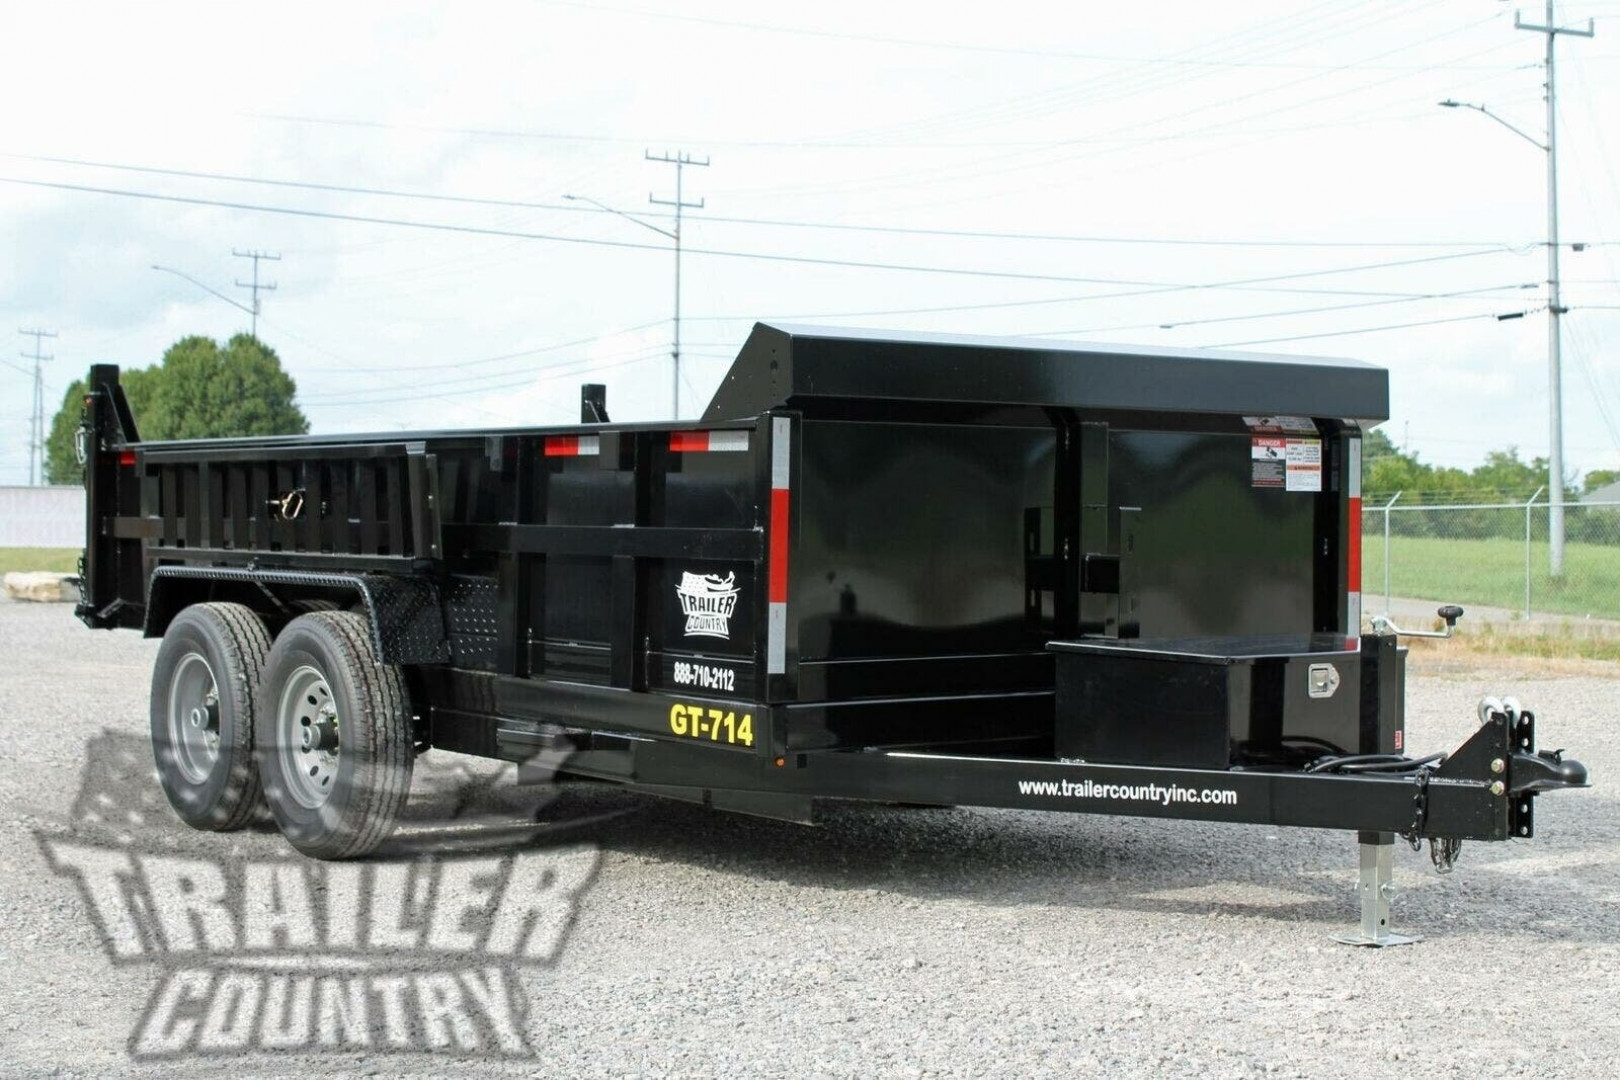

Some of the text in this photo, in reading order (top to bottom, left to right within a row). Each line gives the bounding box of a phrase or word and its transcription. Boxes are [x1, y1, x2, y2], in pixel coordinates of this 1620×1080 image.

[680, 592, 736, 615] TRAILER
[687, 616, 728, 633] COUNTRY
[674, 662, 735, 691] 888-710-2112
[670, 704, 753, 746] GT-714
[1018, 779, 1238, 805] www.trailercountryinc.com
